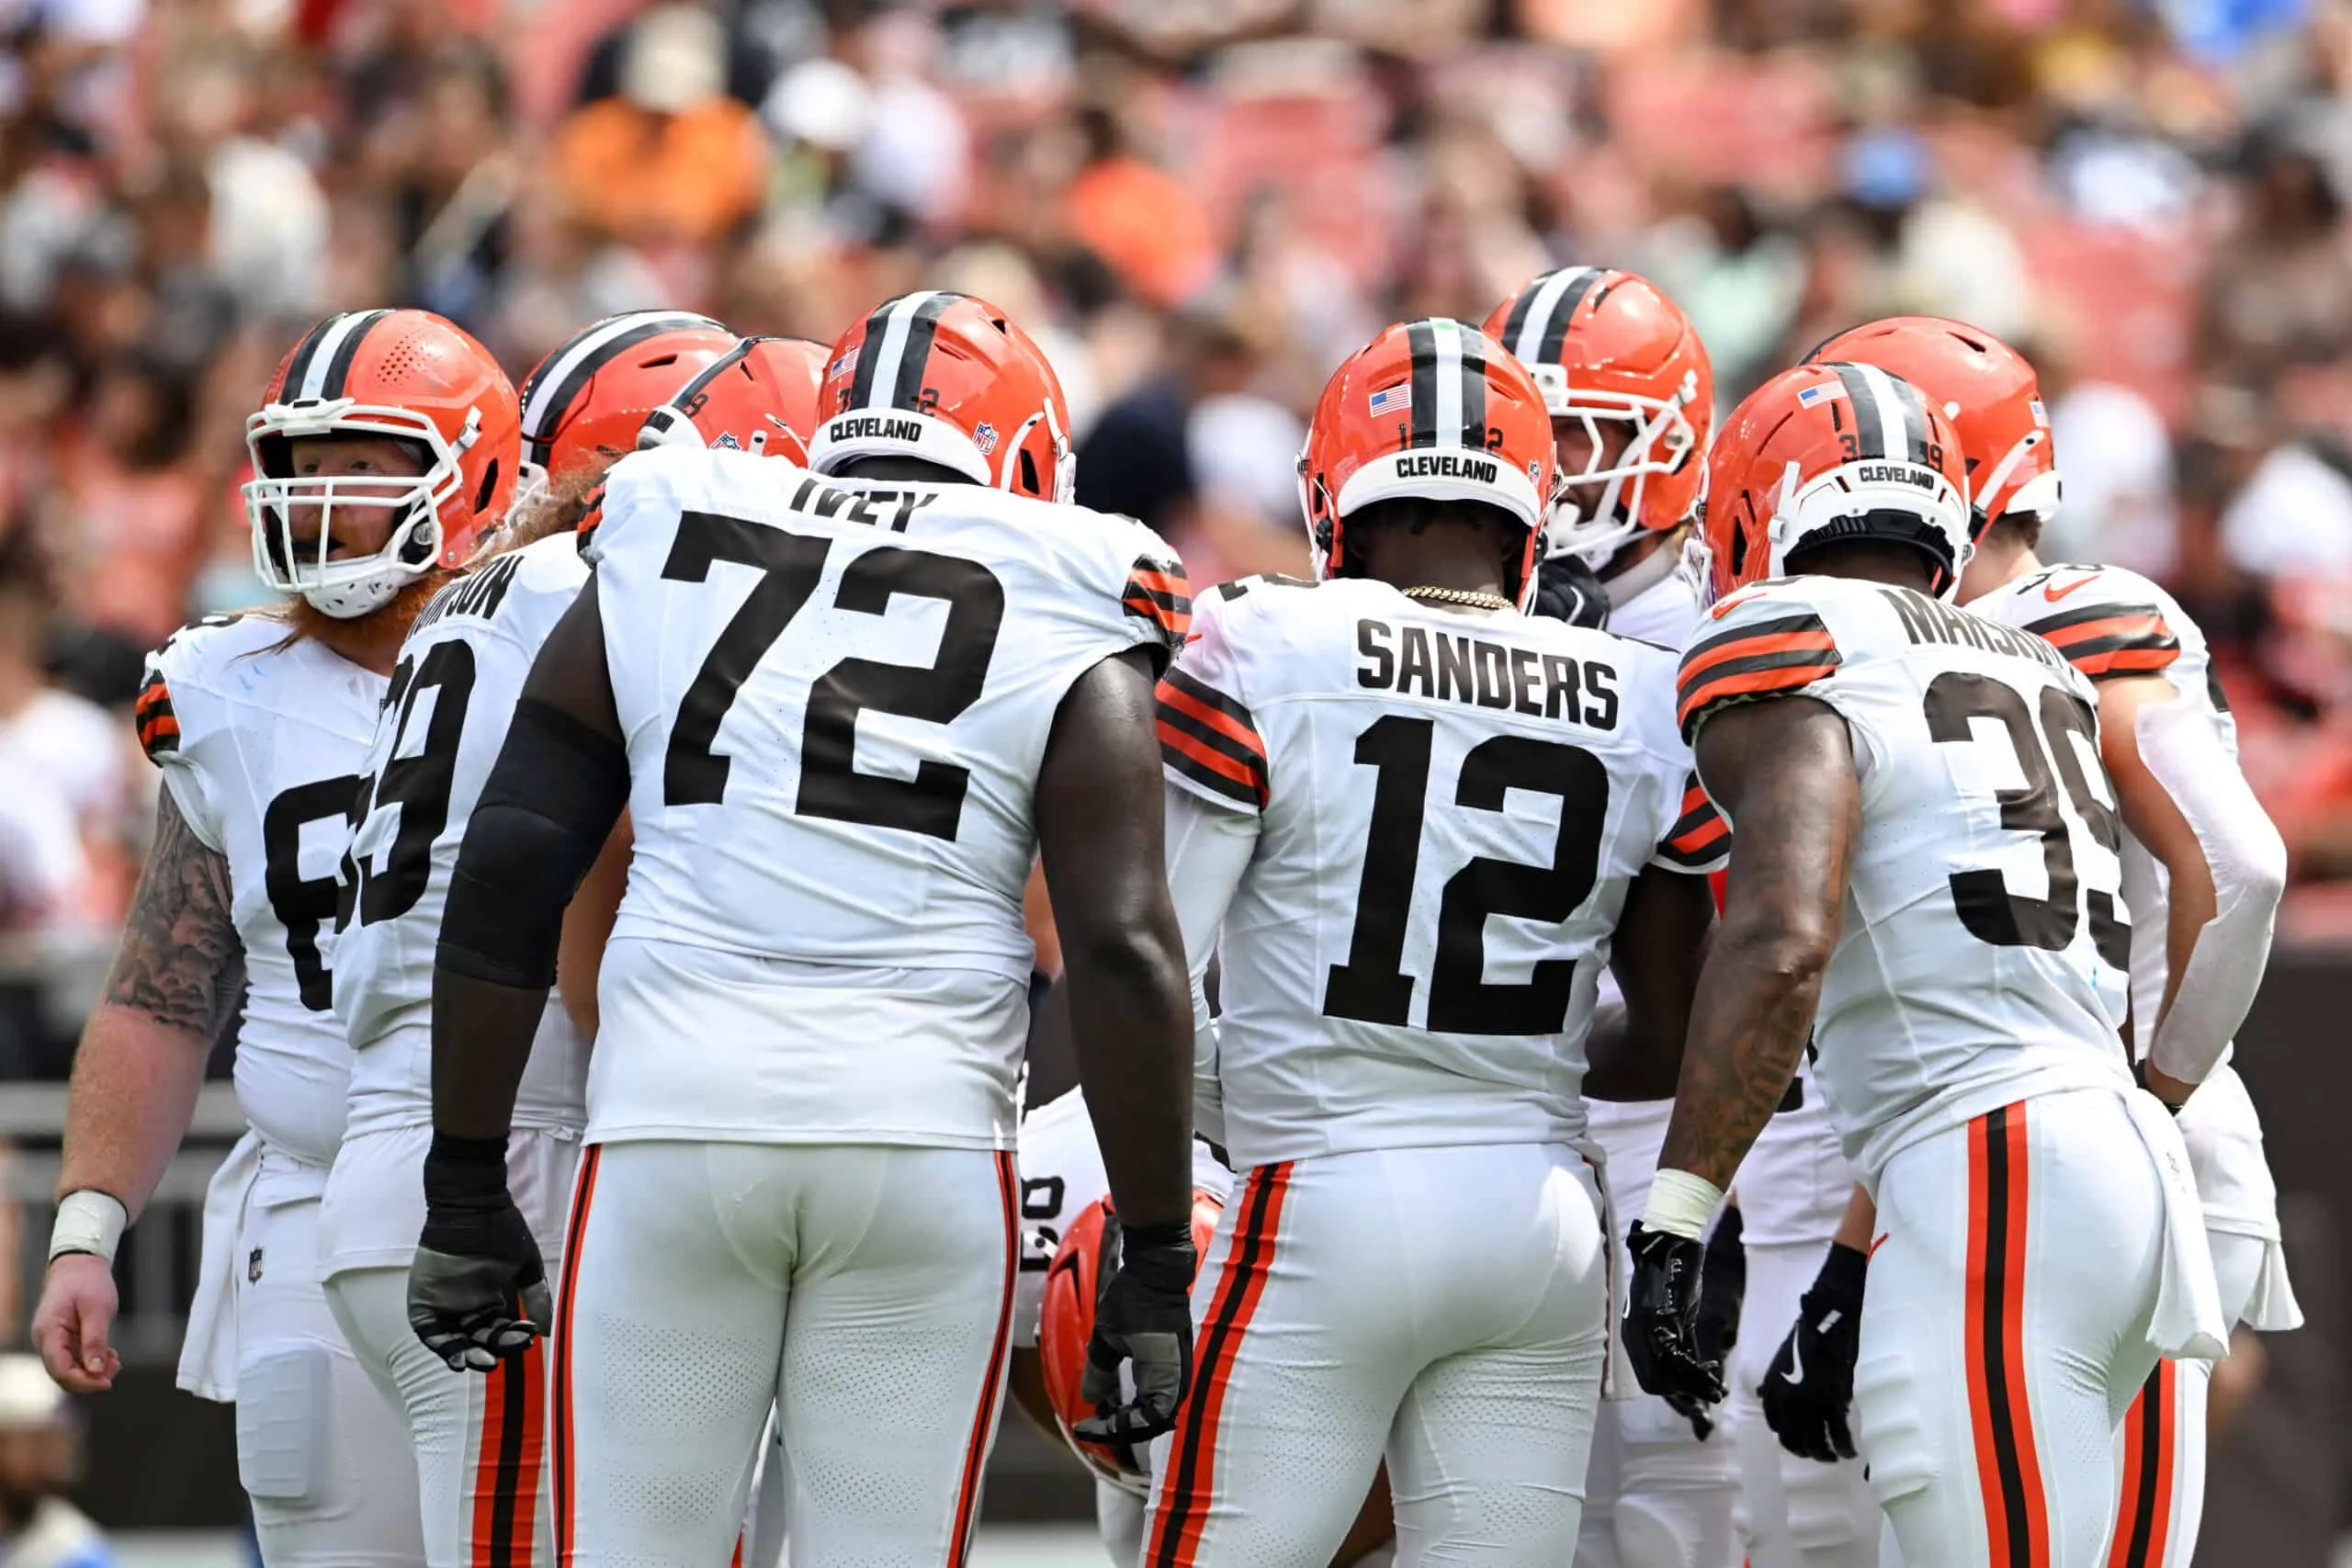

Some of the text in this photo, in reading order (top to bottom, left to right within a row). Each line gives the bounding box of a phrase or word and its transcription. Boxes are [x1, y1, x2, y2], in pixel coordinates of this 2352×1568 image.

[831, 418, 922, 444] CLEVELAND
[1396, 456, 1498, 484] CLEVELAND
[1859, 466, 1934, 490] CLEVELAND
[789, 478, 939, 534] IVEY
[661, 510, 1005, 842] 72
[1357, 618, 1619, 732] SANDERS
[1323, 715, 1609, 1036] 12
